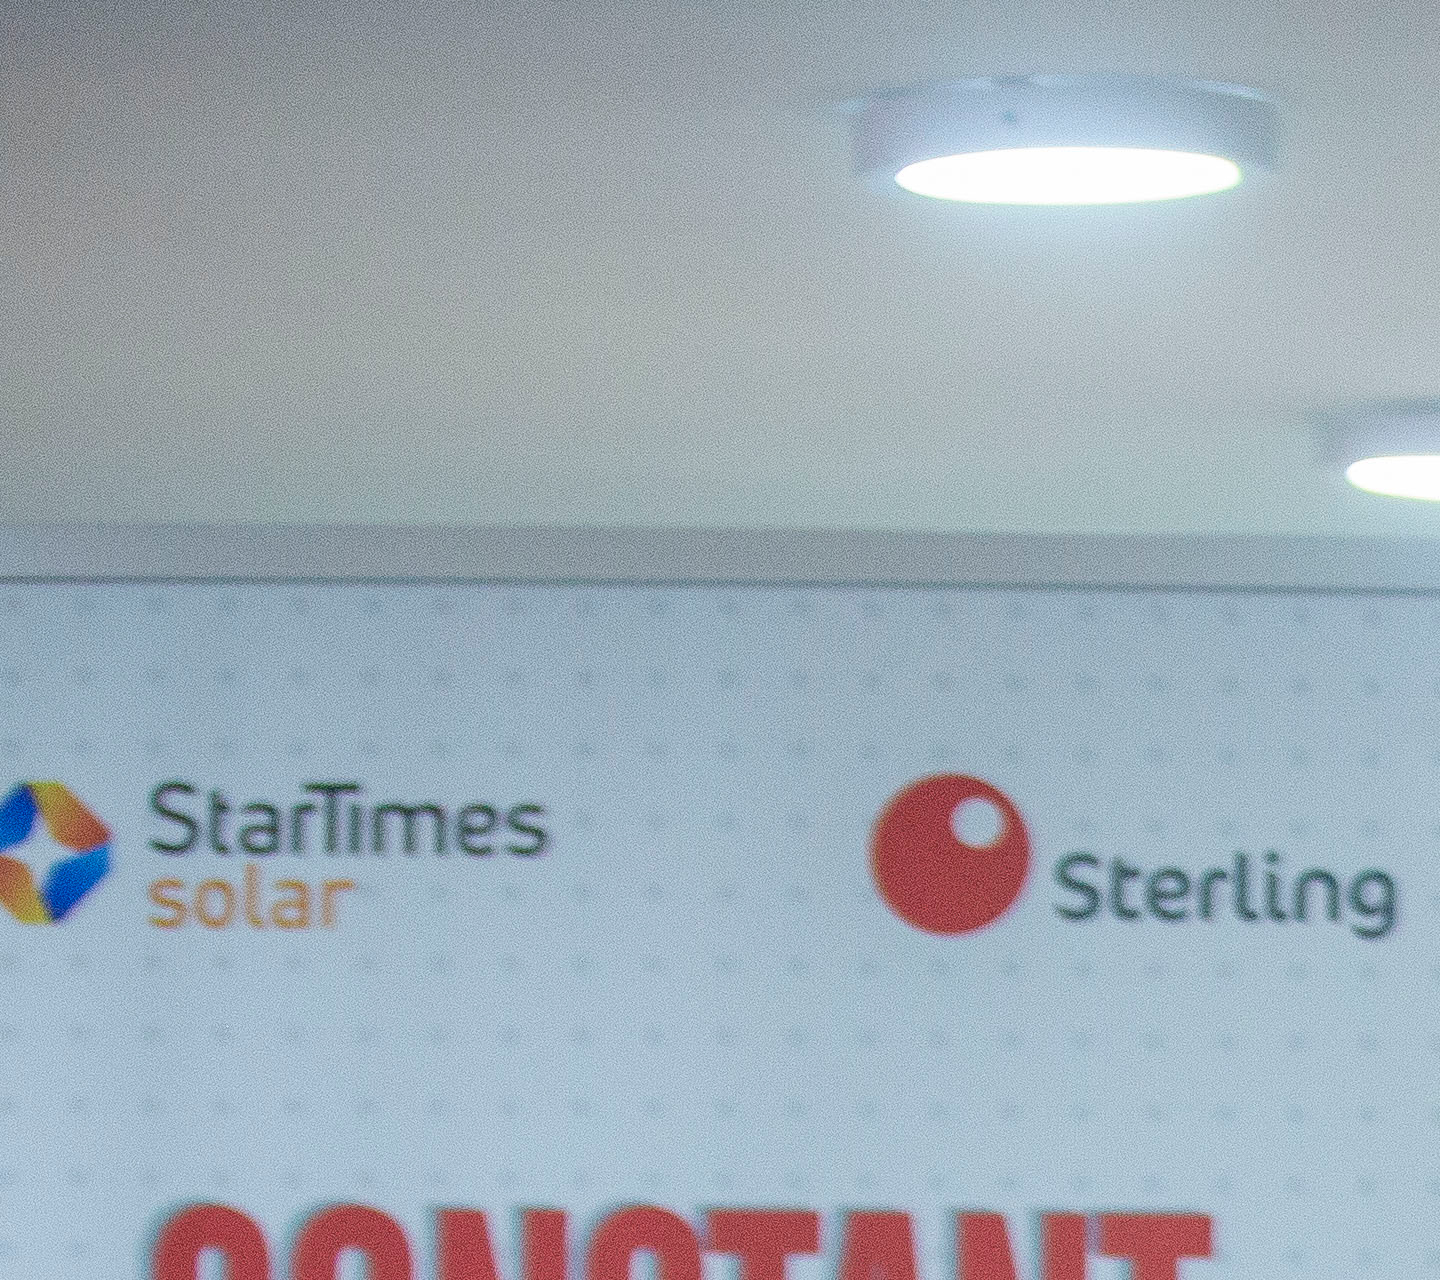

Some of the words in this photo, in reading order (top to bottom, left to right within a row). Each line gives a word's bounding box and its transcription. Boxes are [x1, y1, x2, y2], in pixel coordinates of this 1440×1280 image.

[149, 780, 552, 857] StarTimes
[148, 863, 356, 929] solar
[1053, 850, 1399, 940] Sterling
